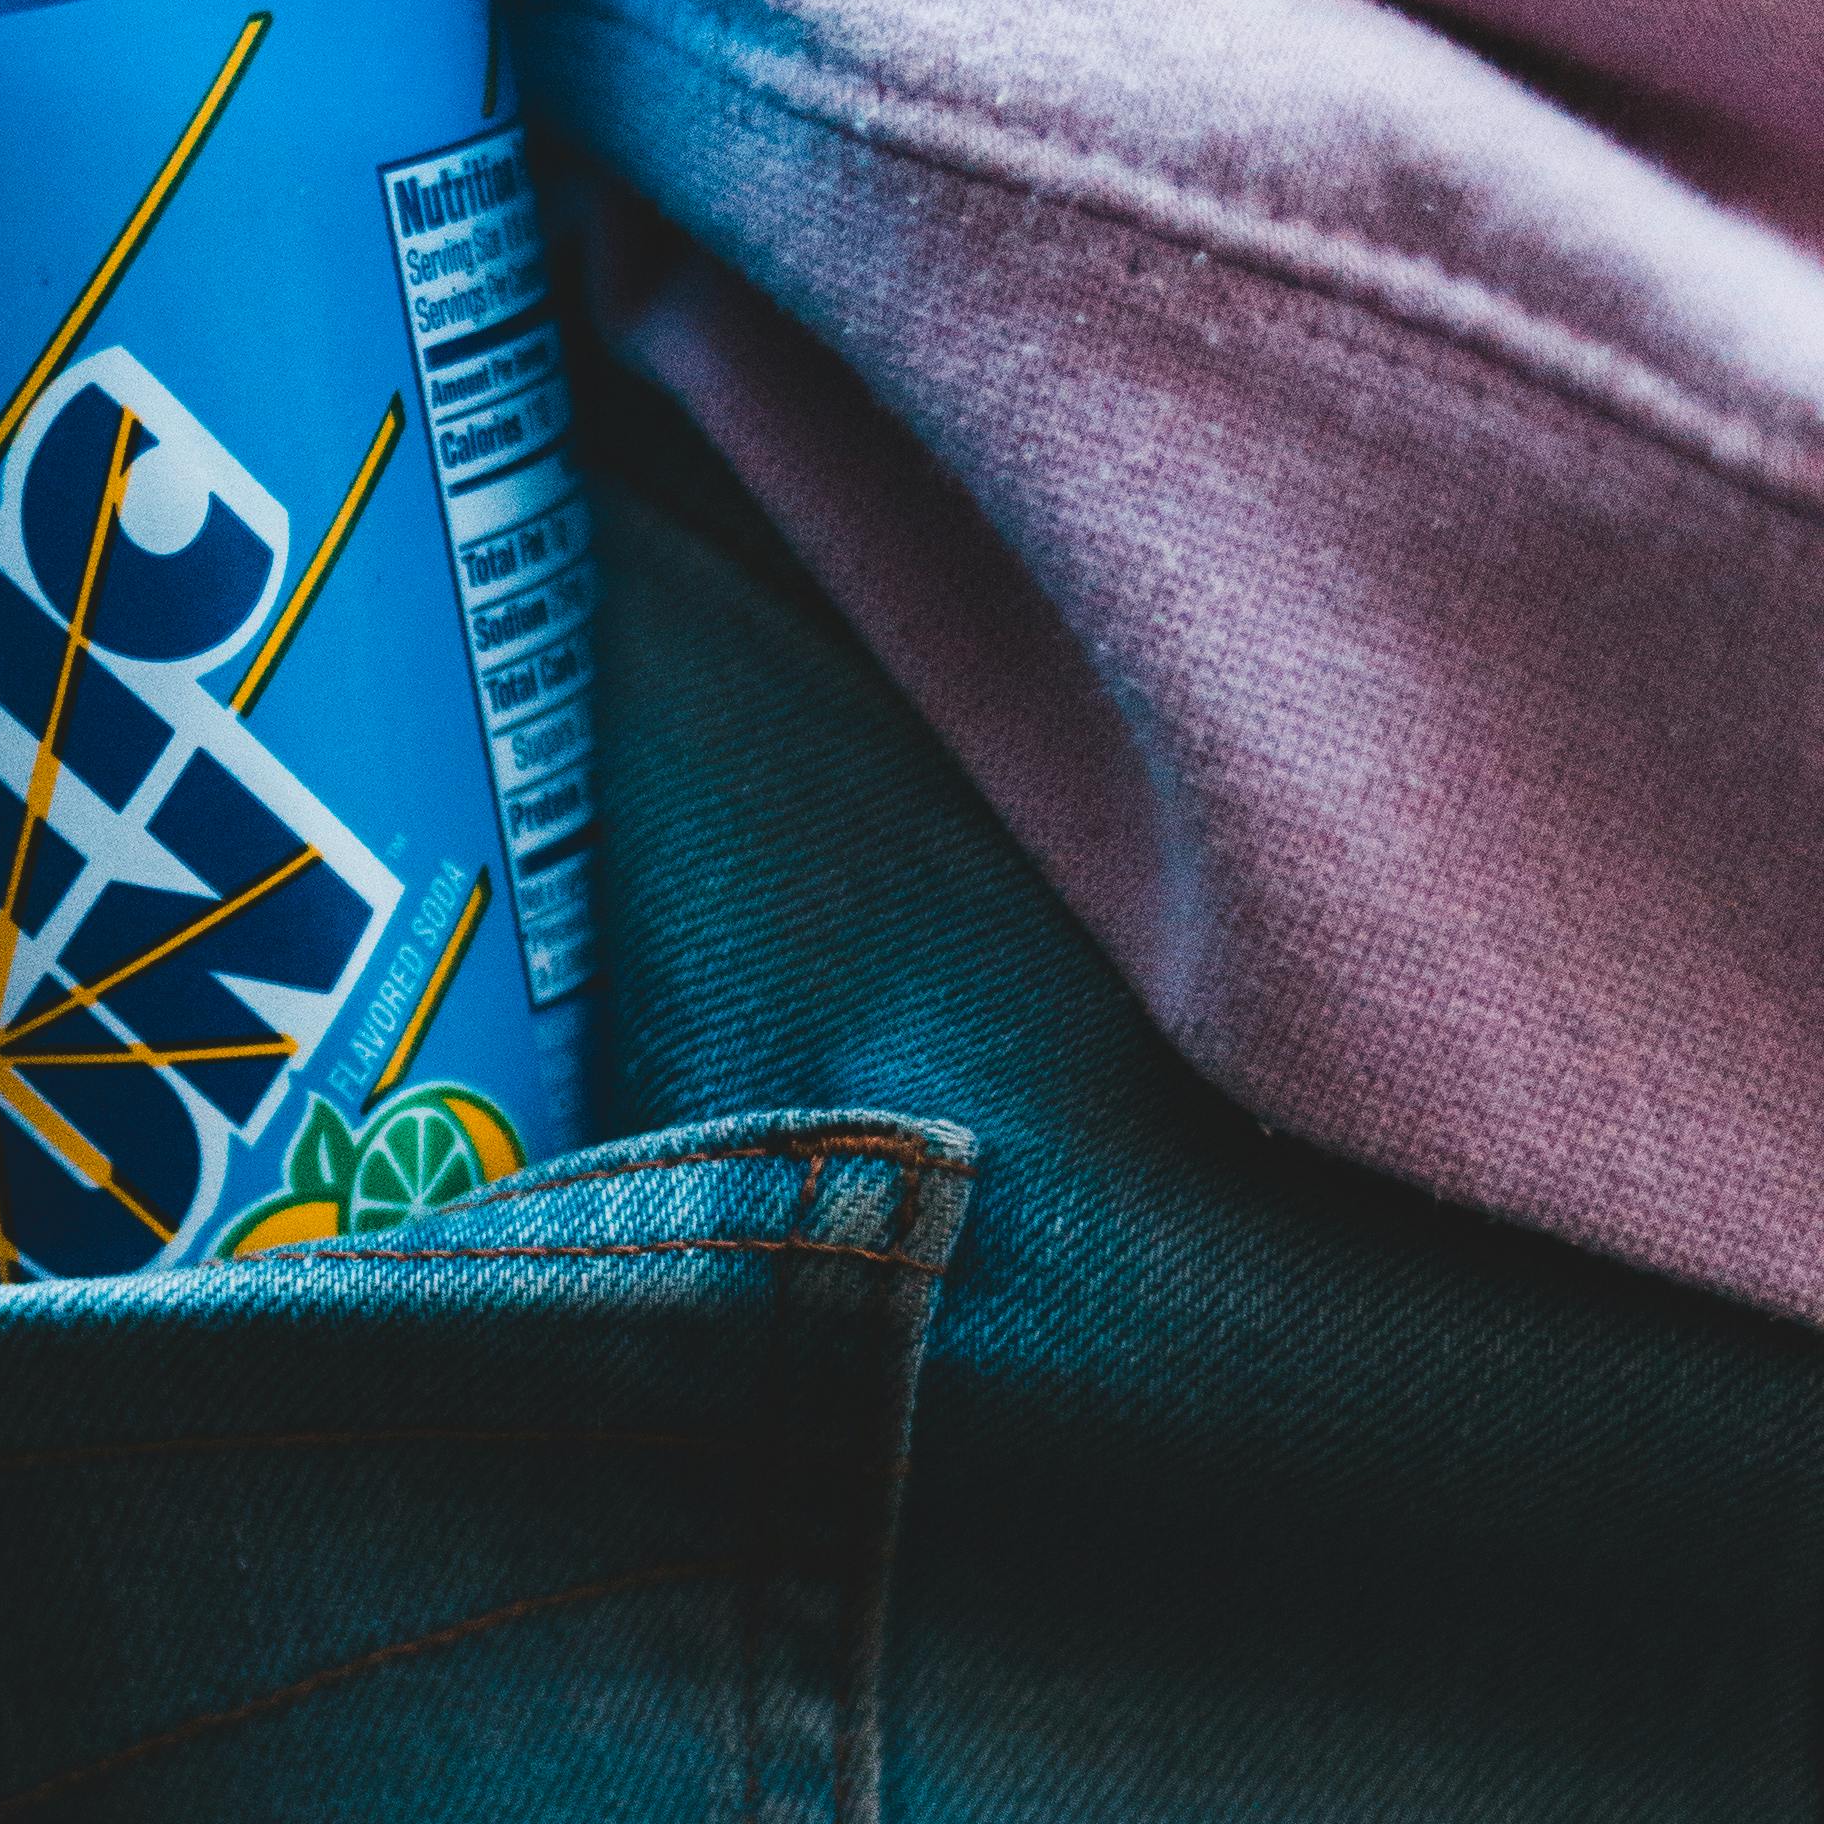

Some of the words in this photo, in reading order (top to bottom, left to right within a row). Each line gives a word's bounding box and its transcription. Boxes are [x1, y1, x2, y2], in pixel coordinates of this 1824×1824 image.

[407, 238, 476, 286] Serving
[328, 943, 427, 1103] FLAVORED
[410, 858, 466, 950] SODA
